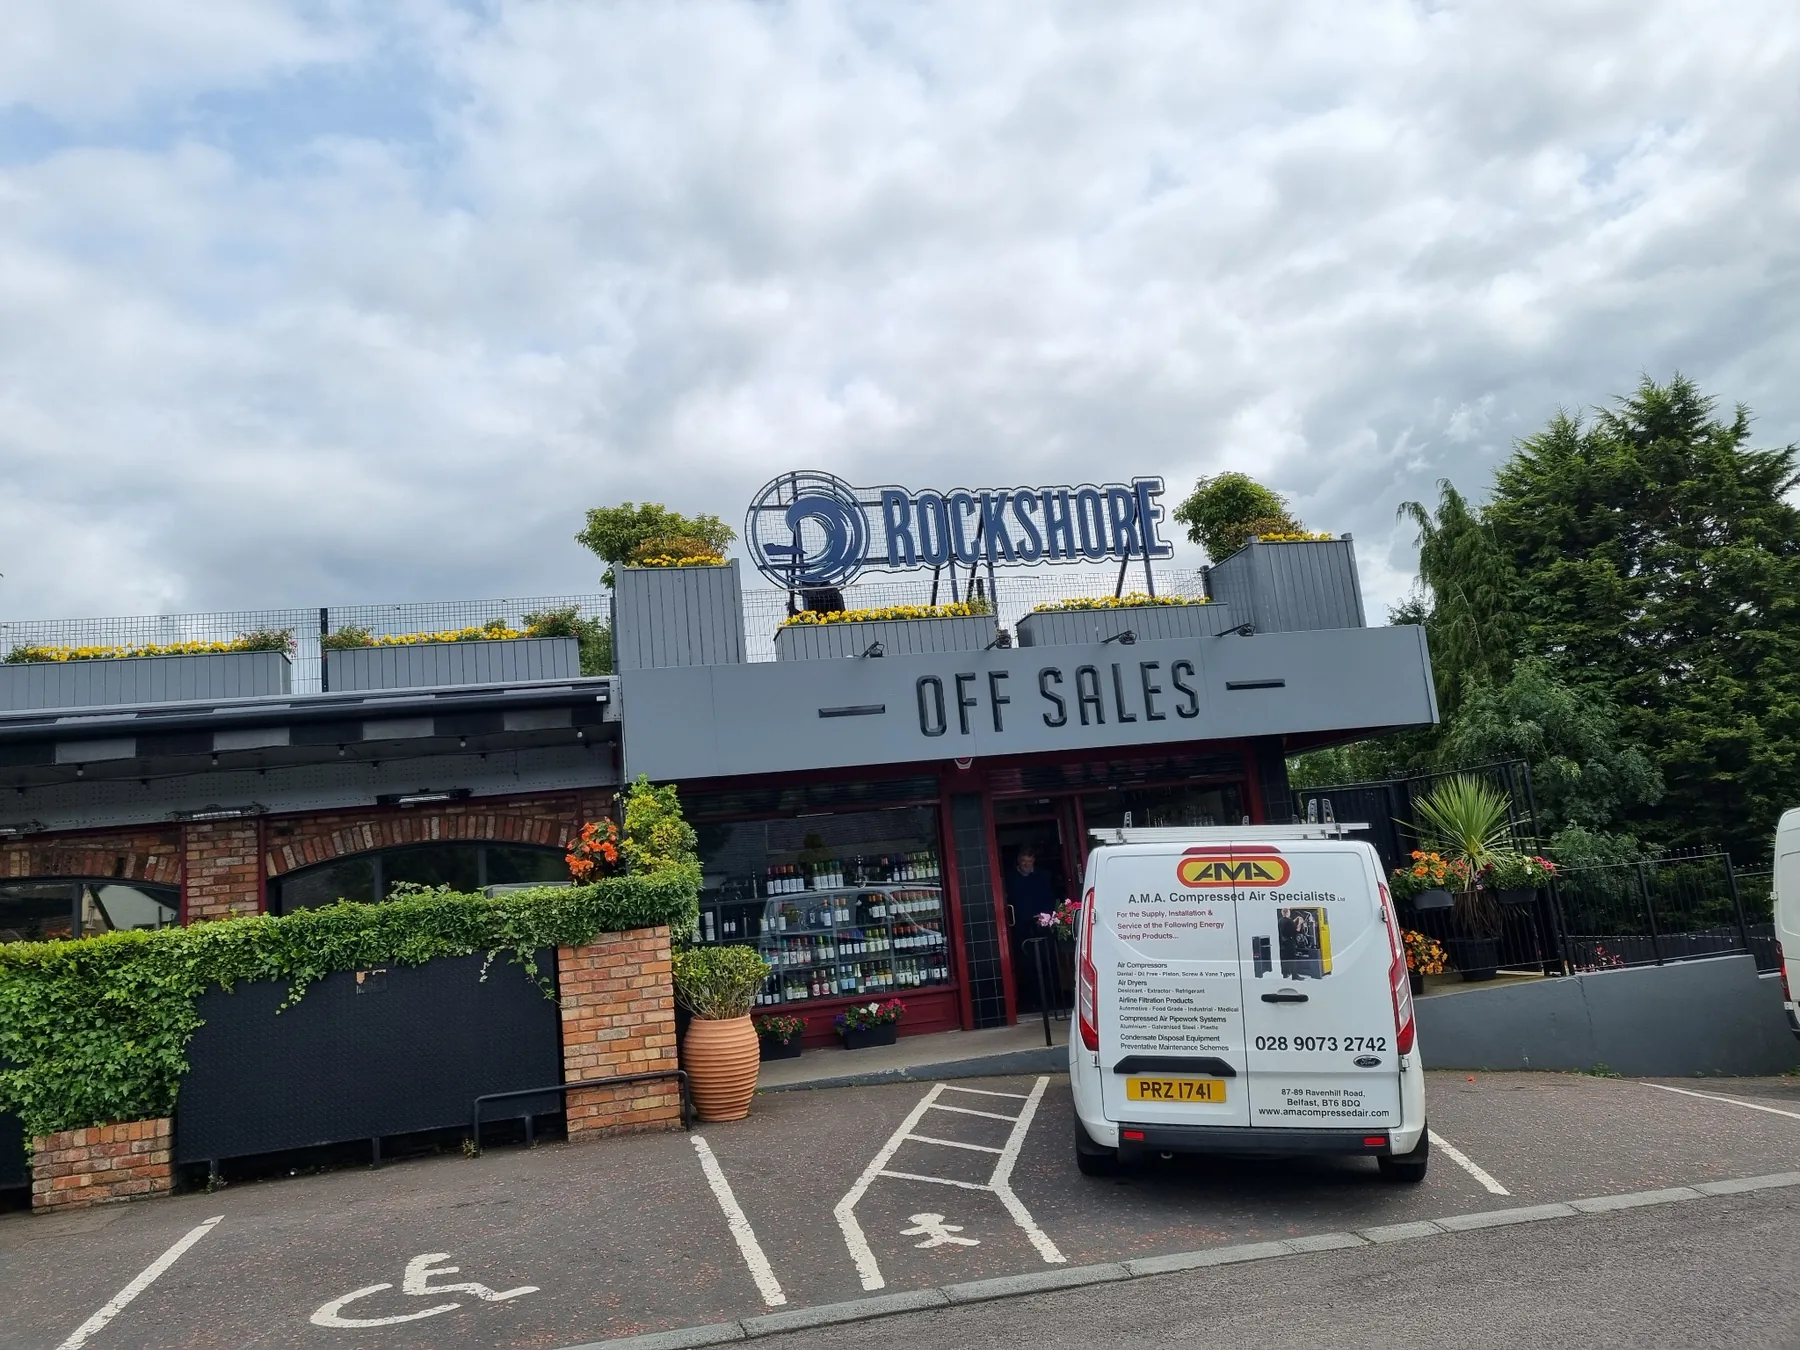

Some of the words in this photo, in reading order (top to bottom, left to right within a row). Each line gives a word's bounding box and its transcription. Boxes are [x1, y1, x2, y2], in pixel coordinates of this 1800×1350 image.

[880, 481, 1171, 567] ROCKSHORE
[916, 669, 1011, 737] OFF
[1038, 659, 1200, 728] SALES
[1192, 862, 1276, 881] AMA
[1128, 893, 1166, 904] A.M.A.
[1169, 891, 1245, 904] Compressed
[1249, 891, 1266, 901] Air
[1269, 891, 1336, 903] Specialists
[1141, 910, 1167, 918] Supply,
[1164, 922, 1198, 930] Following
[1199, 921, 1225, 930] Energy
[1199, 1016, 1227, 1024] Systems
[1158, 1034, 1185, 1042] Disposal
[1255, 1036, 1288, 1051] 028
[1293, 1036, 1338, 1052] 9073
[1344, 1037, 1387, 1052] 2742
[1140, 1081, 1174, 1098] PRZ
[1178, 1082, 1211, 1100] 1741
[1306, 1089, 1341, 1097] Ravenhill
[1343, 1090, 1366, 1098] Road,
[1287, 1098, 1320, 1107] Belfast,
[1322, 1099, 1339, 1107] BT6
[1342, 1100, 1361, 1108] 8DQ
[1258, 1108, 1390, 1118] www.amacompressedair.com
